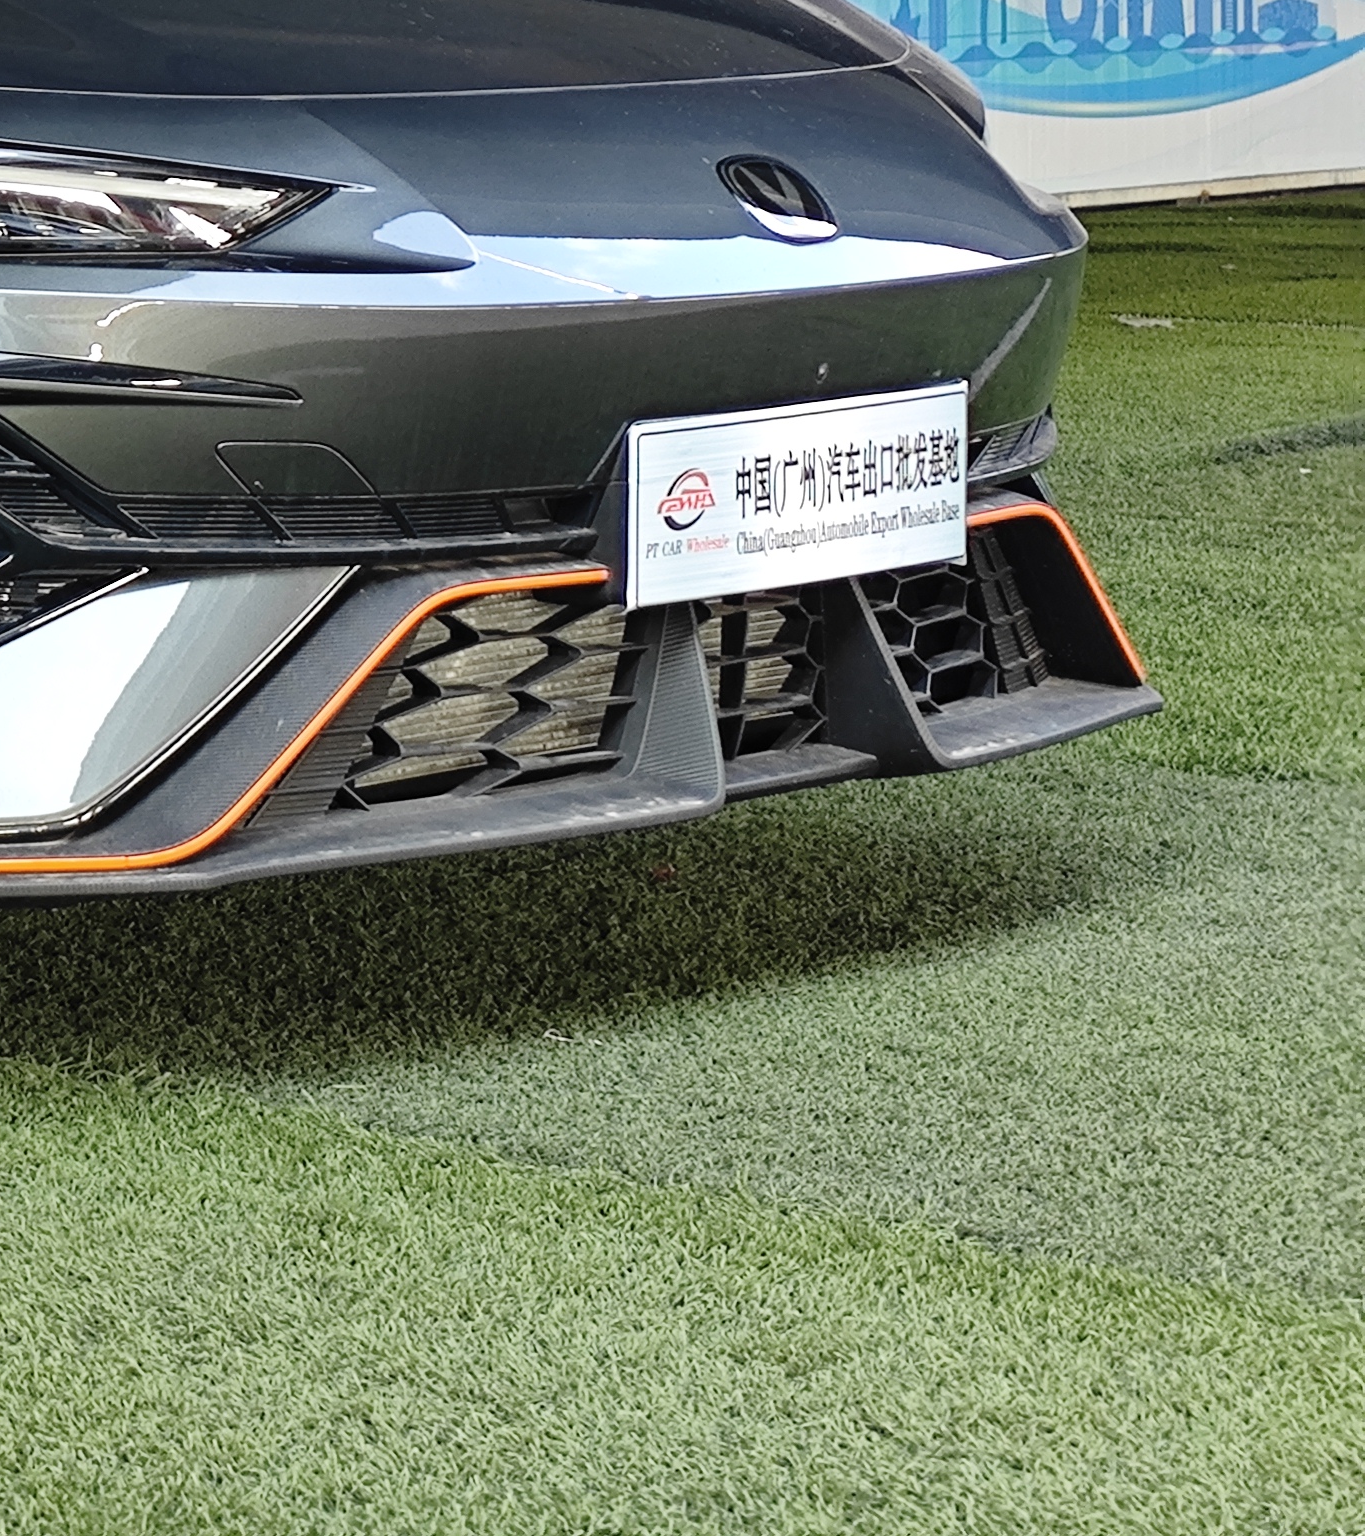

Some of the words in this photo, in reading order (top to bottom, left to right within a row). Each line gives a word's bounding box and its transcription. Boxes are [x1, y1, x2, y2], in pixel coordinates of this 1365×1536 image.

[735, 426, 960, 519] 中国(广州)汽车出口批发基地
[941, 499, 960, 521] Base
[646, 543, 659, 558] PT
[662, 539, 683, 556] CAR
